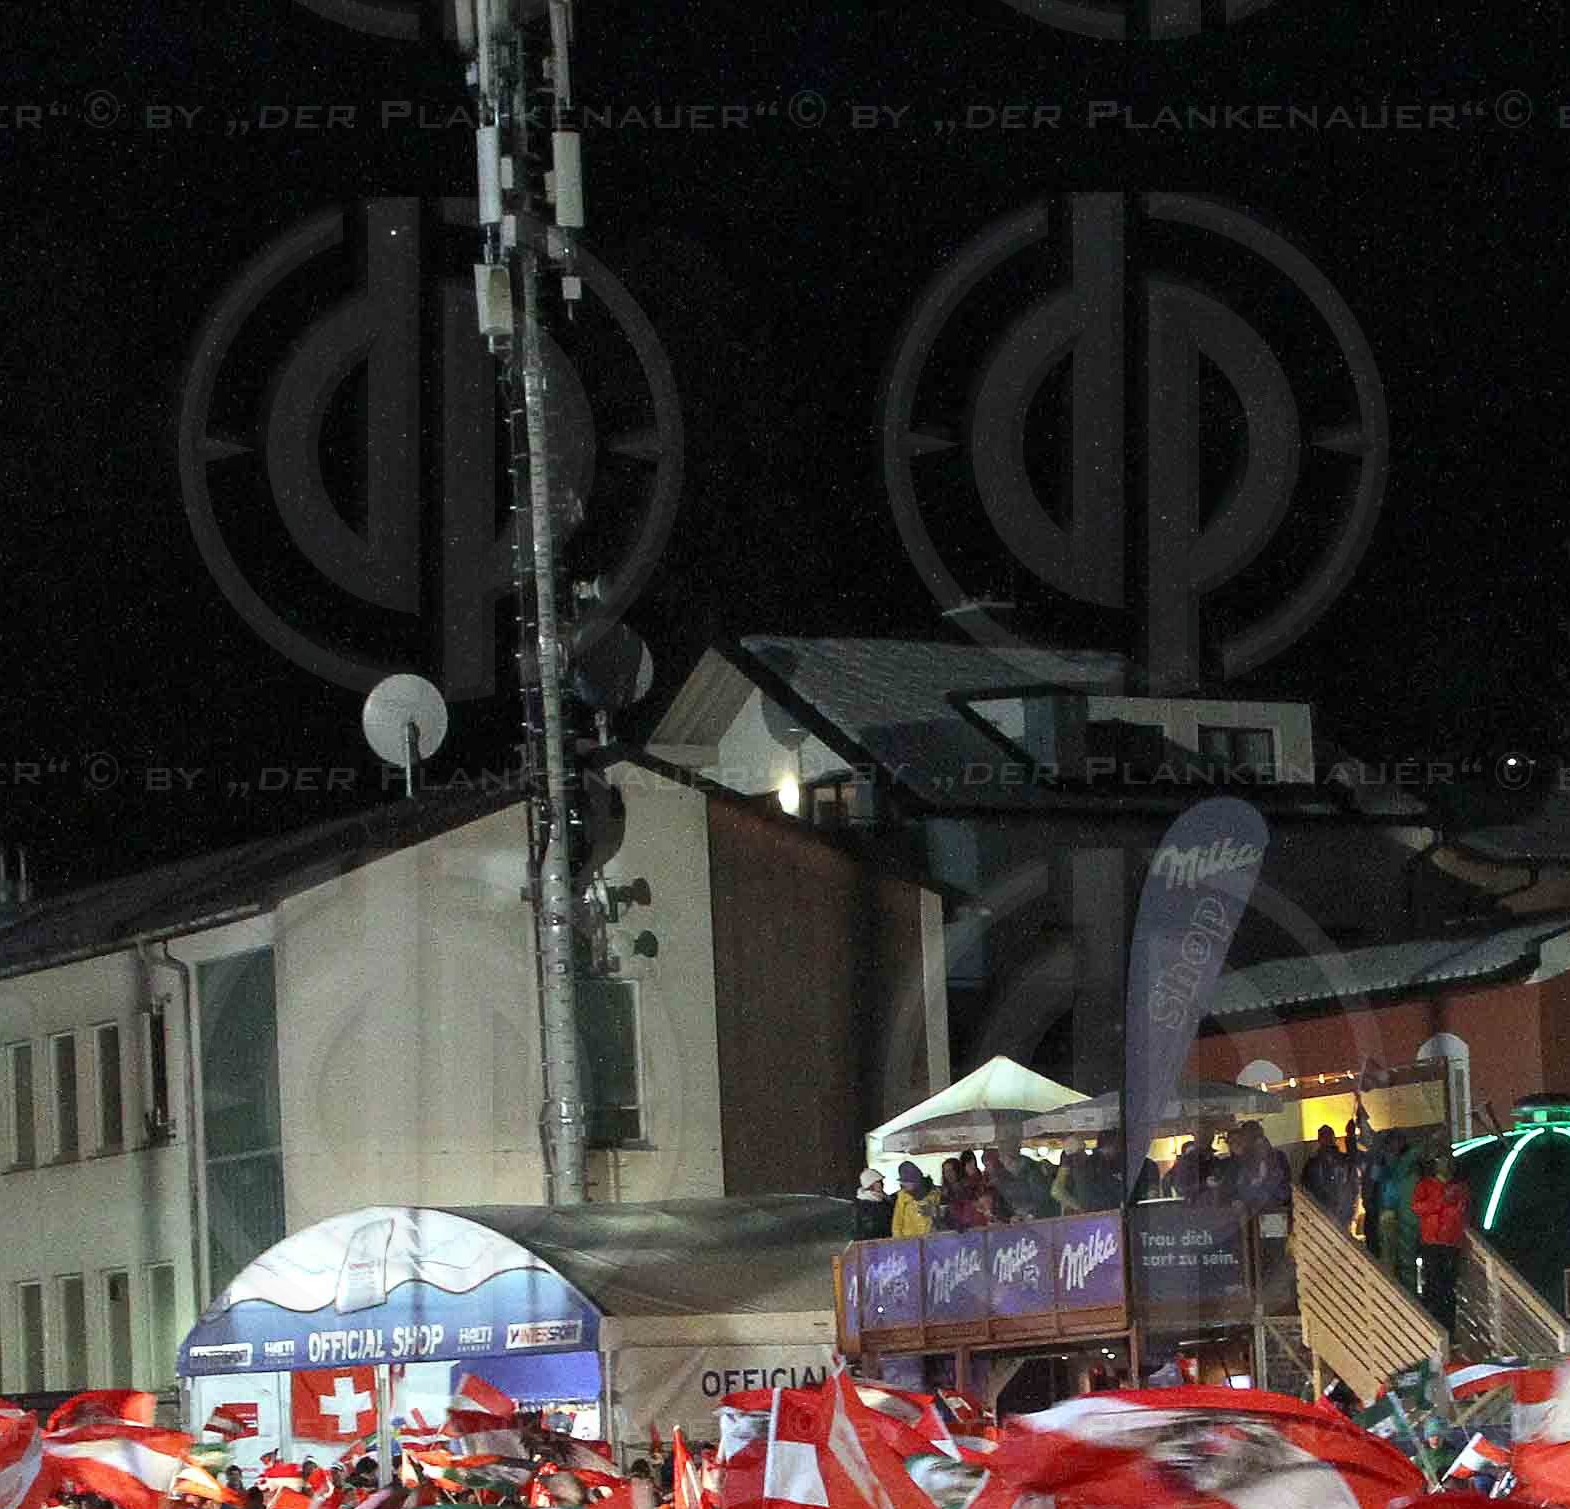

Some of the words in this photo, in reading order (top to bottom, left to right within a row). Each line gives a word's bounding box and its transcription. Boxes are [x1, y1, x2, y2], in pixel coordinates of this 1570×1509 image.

[1153, 838, 1263, 889] Milka
[992, 1237, 1038, 1284] Milka
[1059, 1228, 1118, 1291] Milka
[1140, 1231, 1176, 1247] Trau
[1180, 1229, 1214, 1247] dich
[1141, 1253, 1176, 1267] zart
[1178, 1254, 1198, 1266] zu
[1202, 1250, 1239, 1266] sein.
[927, 1247, 982, 1304] Milka
[308, 1328, 387, 1363] OFFICIAL
[391, 1324, 445, 1358] SHOP
